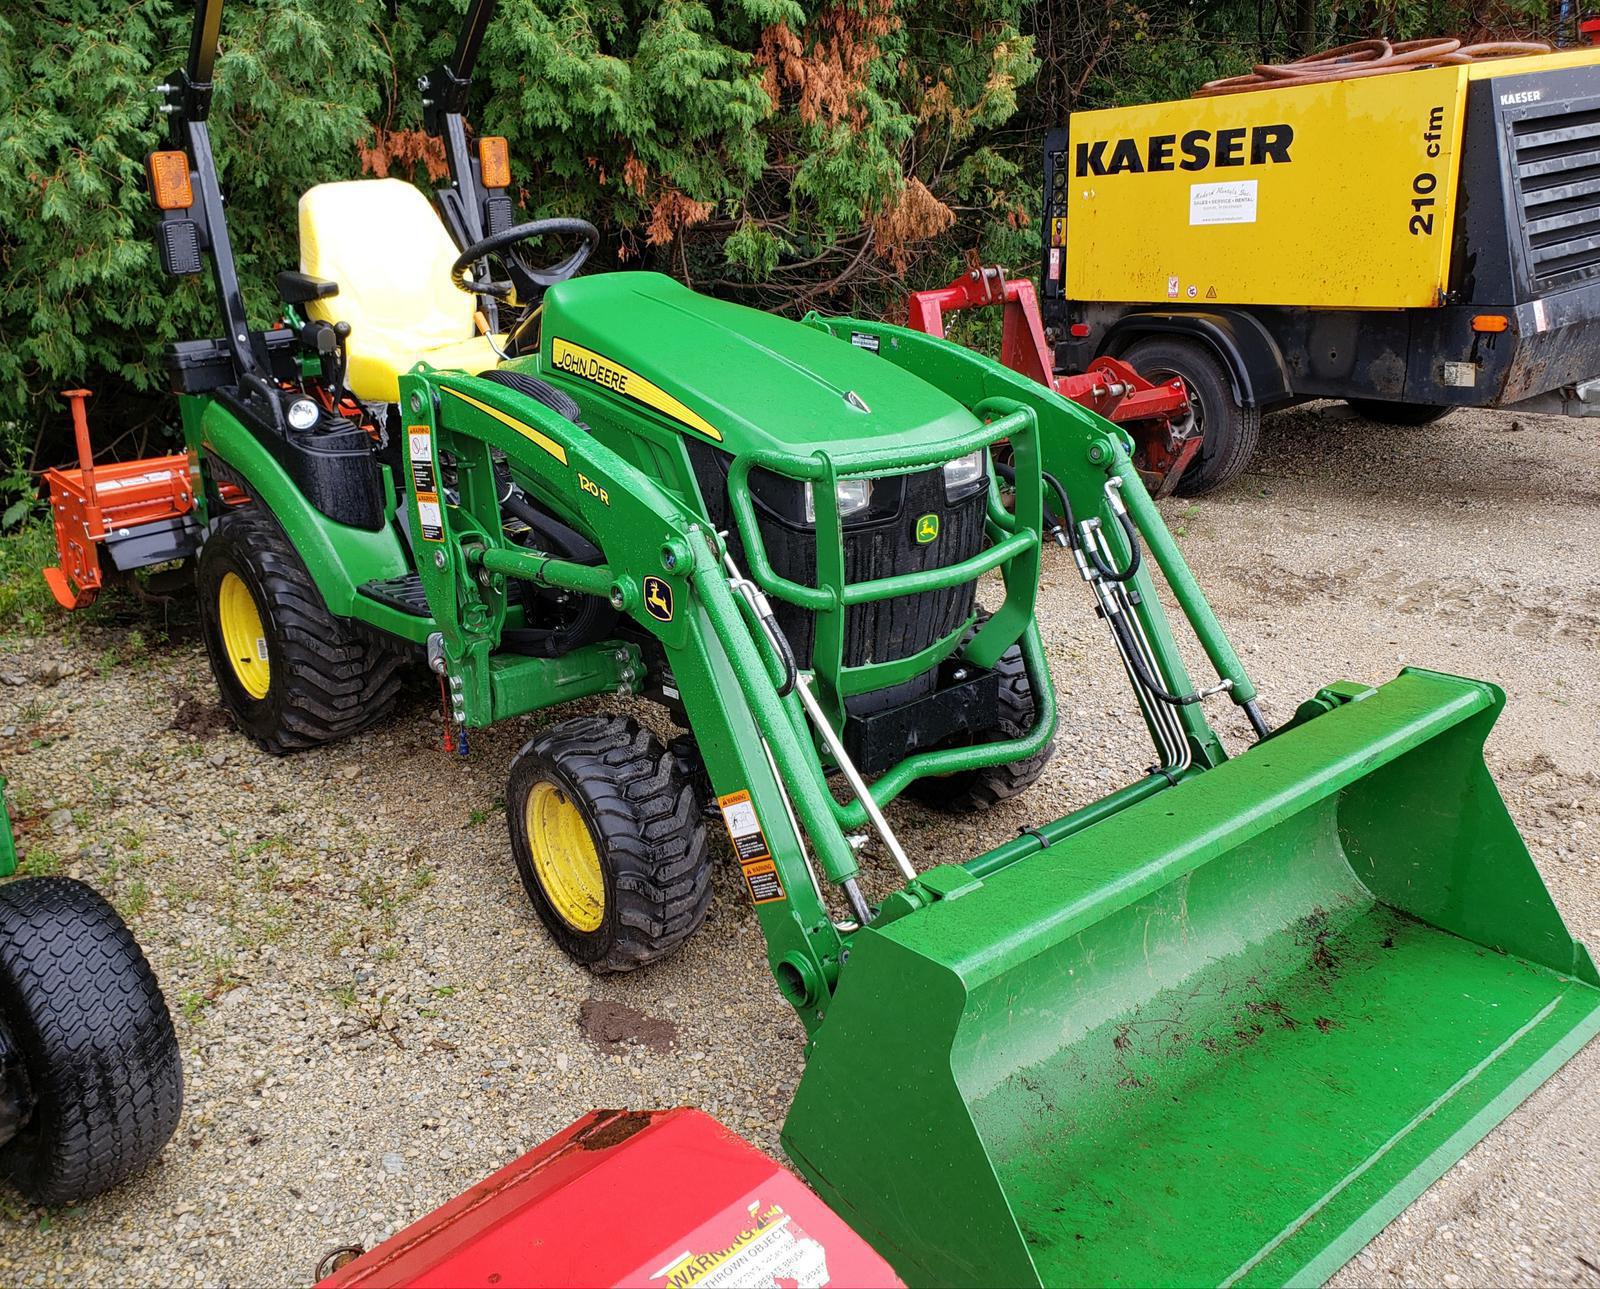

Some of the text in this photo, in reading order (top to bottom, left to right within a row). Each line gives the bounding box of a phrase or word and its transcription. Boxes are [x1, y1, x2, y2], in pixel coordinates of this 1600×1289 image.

[1500, 90, 1541, 106] KAESER
[1075, 124, 1295, 177] KAESER
[1409, 106, 1444, 237] 210 cfm
[558, 349, 628, 392] JOHN DEERE
